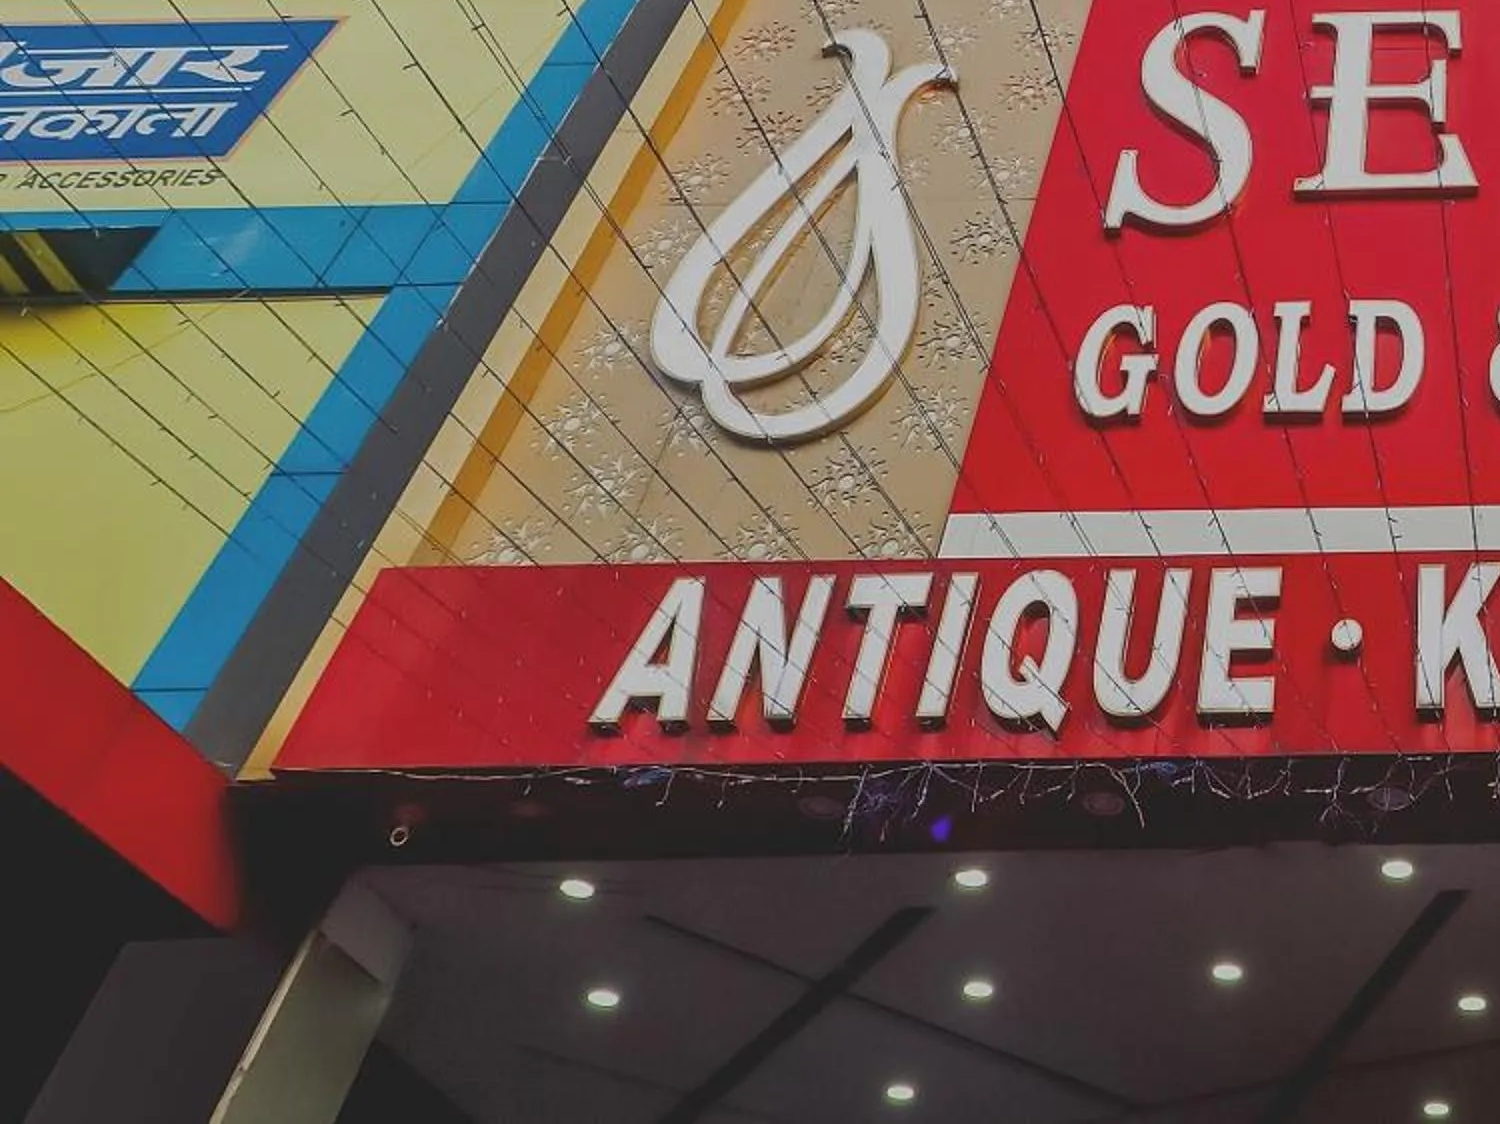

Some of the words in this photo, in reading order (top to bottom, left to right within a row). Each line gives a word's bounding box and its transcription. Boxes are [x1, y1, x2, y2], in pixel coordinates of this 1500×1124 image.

[16, 168, 222, 190] ACCESSORIES
[1073, 300, 1426, 420] GOLD
[587, 567, 1284, 736] ANTIQUE
